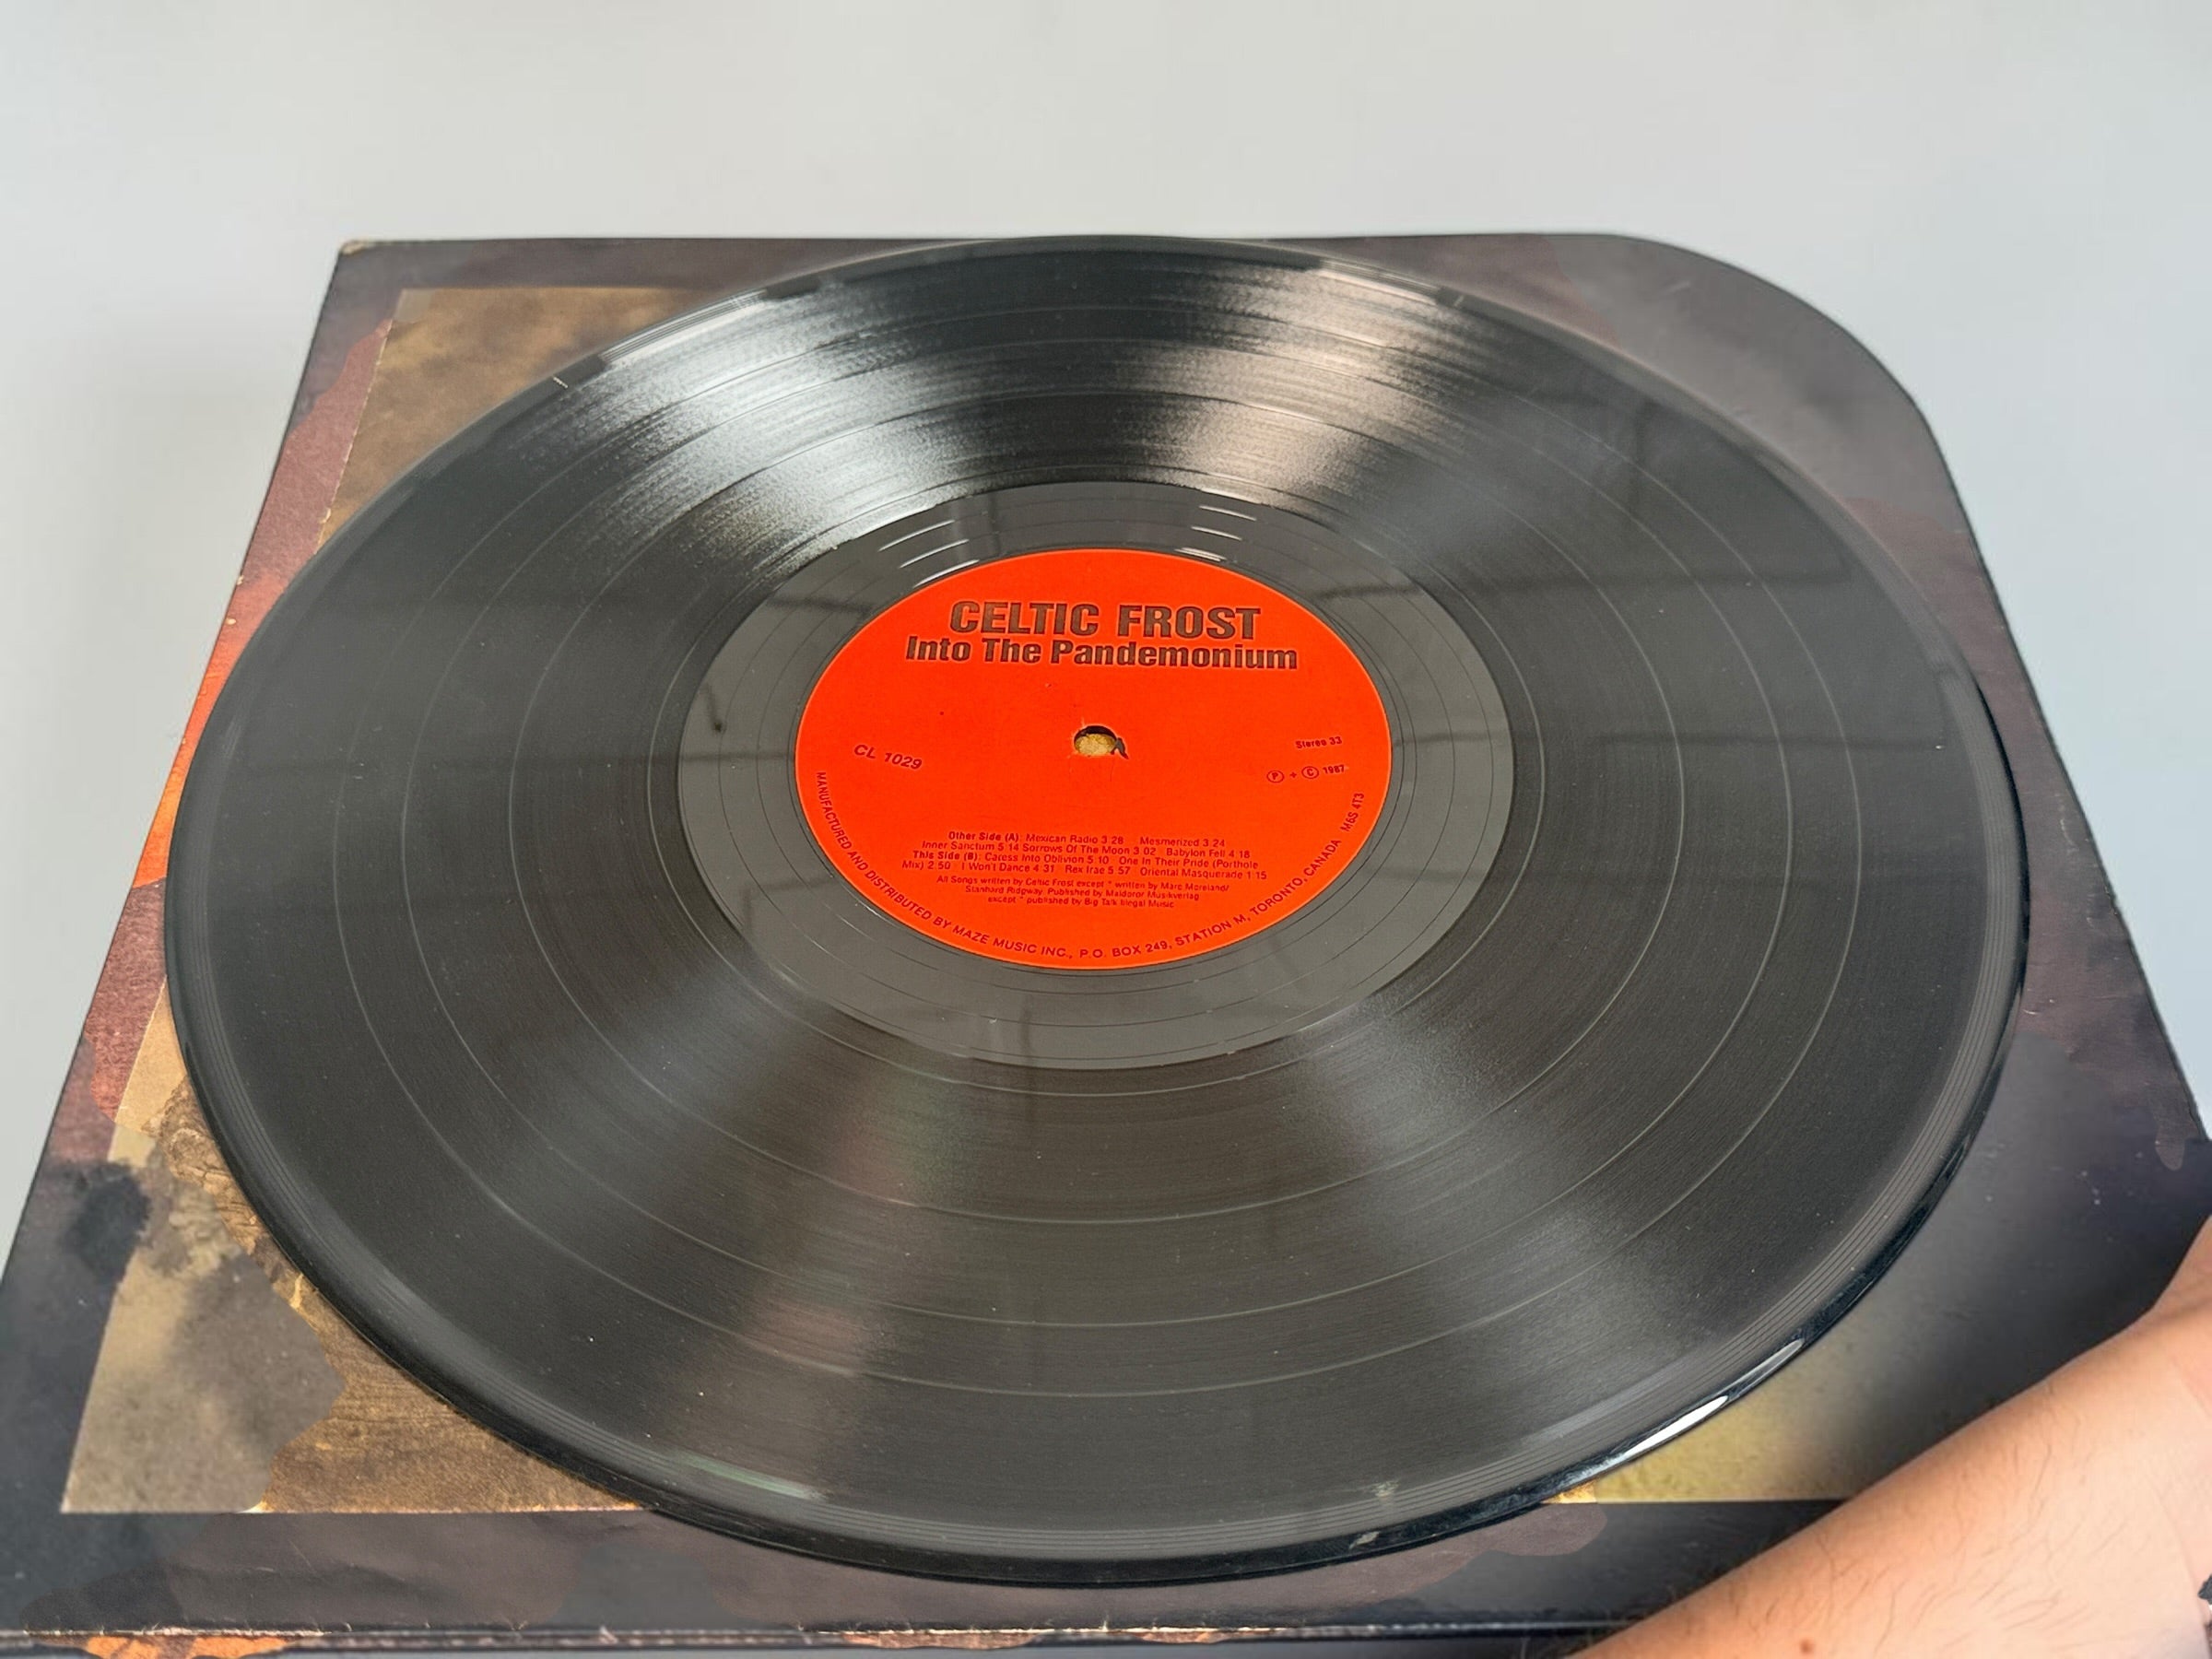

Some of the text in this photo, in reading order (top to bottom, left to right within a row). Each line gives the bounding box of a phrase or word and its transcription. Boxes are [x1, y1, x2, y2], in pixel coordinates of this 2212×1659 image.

[950, 601, 1261, 640] CELTIC FROST
[906, 635, 1298, 669] Into The Pandemonium
[1295, 736, 1343, 749] Stereo 33
[853, 744, 923, 770] CL 1029
[1323, 764, 1345, 774] 1987
[948, 831, 975, 840] Other
[979, 832, 1001, 841] Side
[1026, 834, 1066, 842] Mexican
[1070, 835, 1098, 844] Radio
[1140, 837, 1199, 847] Mesmerized
[923, 841, 947, 849] Inner
[951, 841, 994, 851] Sanctum
[1023, 843, 1063, 853] Sorrows
[1066, 844, 1077, 853] Of
[1080, 845, 1099, 853] The
[1102, 846, 1130, 854] Moon
[1167, 848, 1206, 858] Babylon
[817, 771, 853, 850] MANUFACTURED
[848, 851, 869, 872] AND
[865, 870, 932, 921] DISTRIBUTED
[933, 915, 952, 930] BY
[952, 924, 991, 945] MAZE
[993, 937, 1037, 954] MUSIC
[1112, 945, 1142, 958] BOX
[1146, 940, 1172, 953] 249,
[1174, 920, 1232, 947] STATION
[1249, 877, 1308, 916] TORONTO,
[1303, 838, 1342, 877] CANADA
[1339, 811, 1359, 832] M6S
[1351, 793, 1365, 809] 4T3
[913, 851, 934, 859] This
[938, 852, 960, 860] Side
[985, 853, 1018, 862] Caress
[1022, 854, 1041, 863] Into
[1044, 854, 1084, 864] Oblivion
[1119, 856, 1138, 865] One
[1142, 857, 1151, 865] In
[1155, 857, 1180, 866] Their
[1183, 859, 1209, 867] Pride
[1213, 859, 1259, 869] (Porthole
[902, 860, 924, 870] Mix)
[969, 862, 996, 871] Won't
[999, 863, 1030, 872] Dance
[1065, 865, 1083, 874] Rex
[1087, 865, 1105, 875] Irae
[1140, 866, 1179, 877] Oriental
[1182, 868, 1243, 879] Masquerade
[951, 876, 978, 885] Songs
[981, 877, 1010, 885] written
[1013, 877, 1023, 887] by
[1077, 880, 1104, 888] except
[1115, 881, 1145, 889] written
[1148, 882, 1158, 890] by
[1160, 882, 1182, 890] Marc
[1027, 897, 1069, 905] published
[1072, 898, 1083, 906] by
[1085, 898, 1099, 907] Big
[1148, 900, 1174, 908] Music
[1048, 888, 1090, 896] Published
[1093, 889, 1102, 898] by
[1106, 889, 1145, 898] Maldoror
[1147, 891, 1200, 901] Musikverlag
